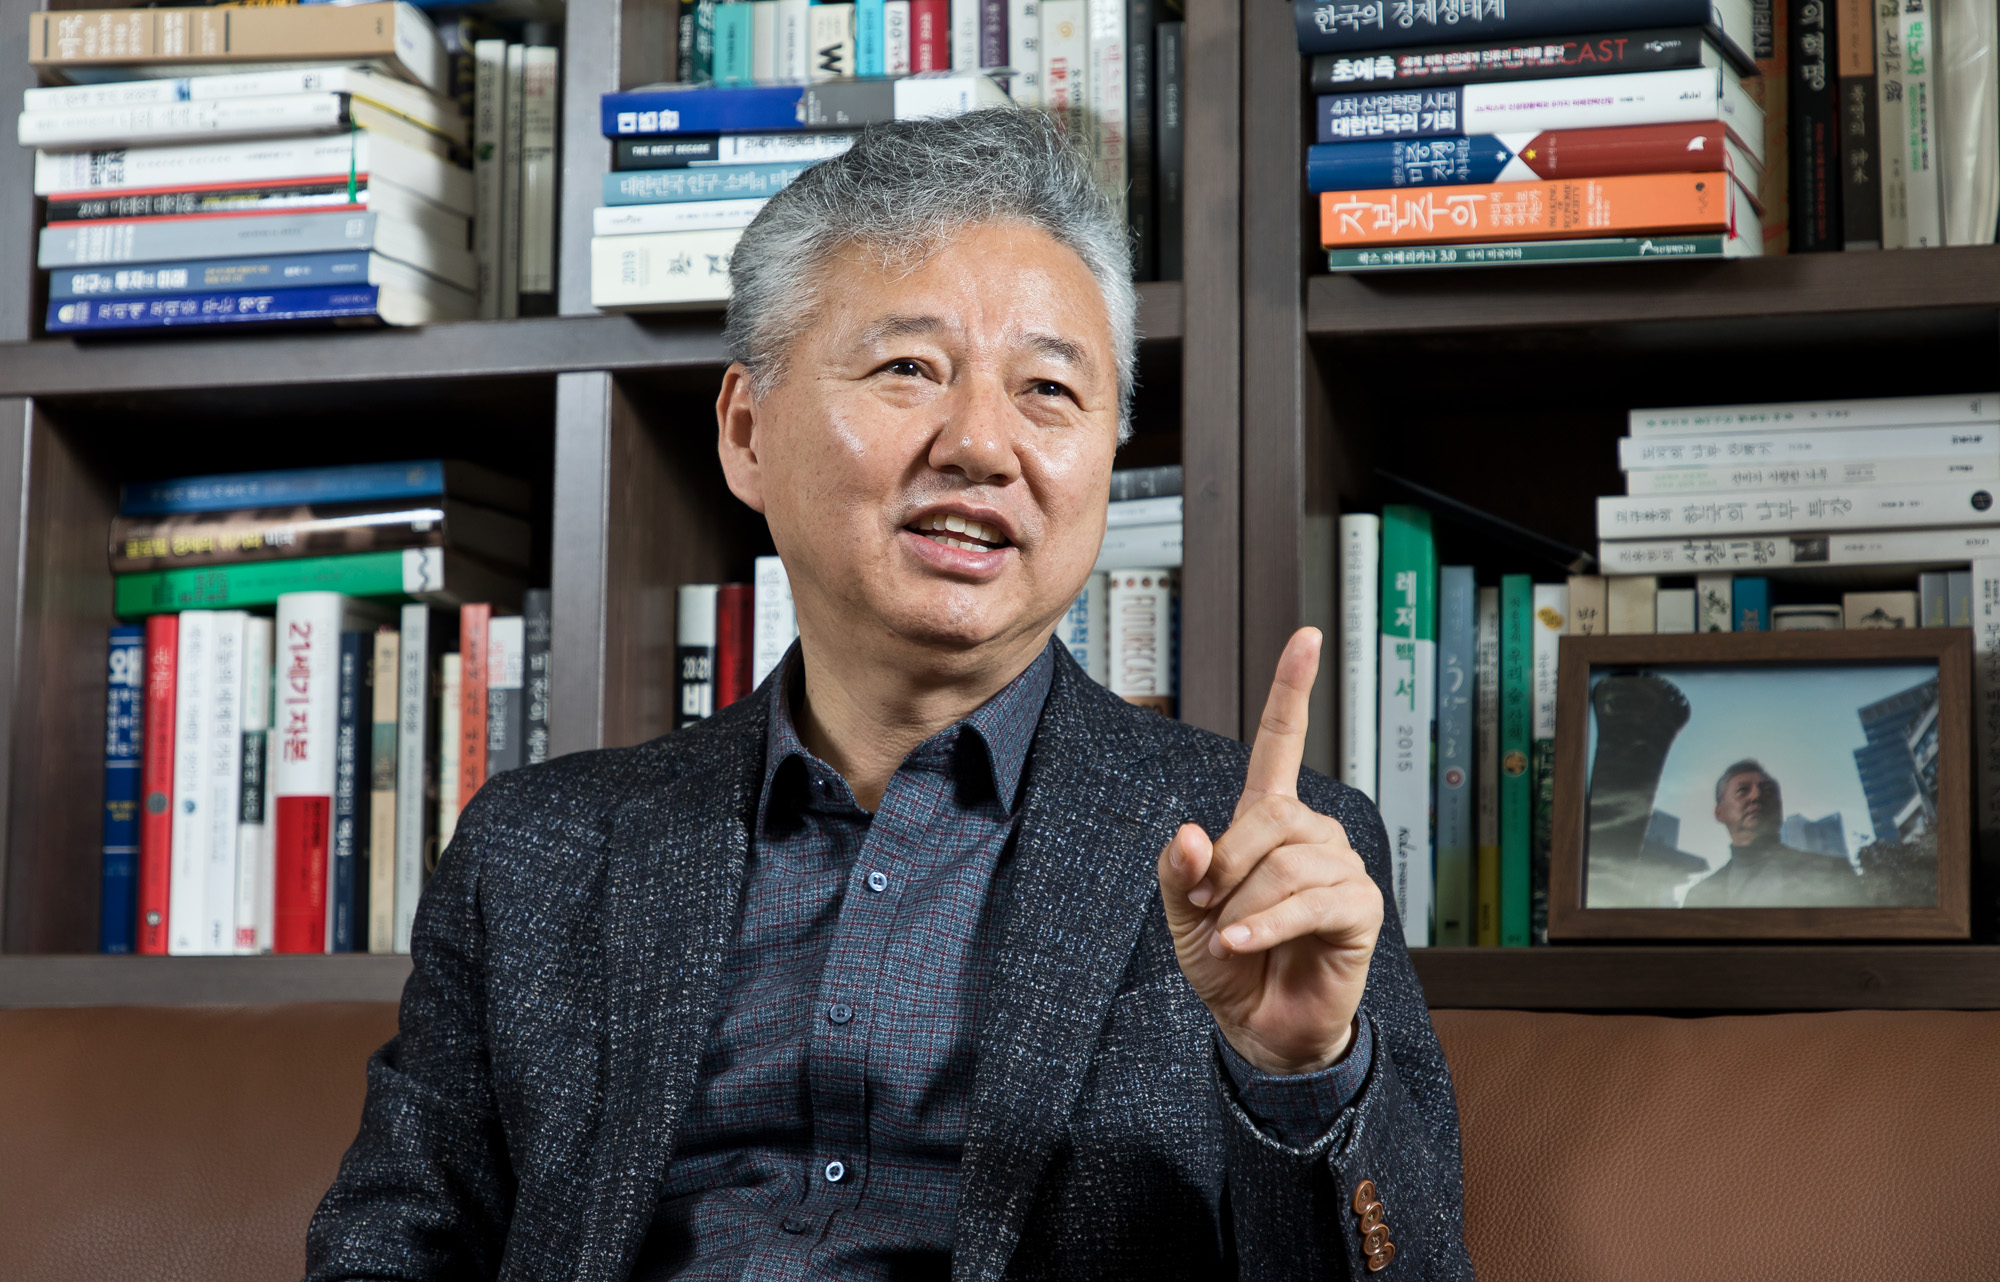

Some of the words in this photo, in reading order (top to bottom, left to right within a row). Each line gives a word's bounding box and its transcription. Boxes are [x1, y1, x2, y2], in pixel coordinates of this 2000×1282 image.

[1313, 1, 1383, 34] 한국의
[1392, 0, 1505, 29] 경제생태계
[1331, 56, 1396, 82] 초예측
[1482, 48, 1511, 63] 인류의
[1512, 46, 1542, 59] 미래를
[1907, 21, 1926, 75] 박노자
[1330, 97, 1357, 116] 4차
[1361, 93, 1422, 115] 산업혁명
[1424, 91, 1456, 110] 시대
[1331, 112, 1418, 137] 대한민국의
[1421, 110, 1456, 131] 기회
[1404, 141, 1430, 183] 미중
[1429, 141, 1455, 181] 전쟁
[1456, 137, 1471, 181] 시나리오
[621, 174, 684, 197] 대한민국
[1333, 192, 1486, 236] 자본주의
[1383, 250, 1437, 262] 아메리카나
[1439, 250, 1457, 262] 3.0
[1682, 501, 1747, 524] 한국의
[1757, 501, 1800, 521] 나무
[1808, 499, 1853, 520] 특강
[1122, 595, 1157, 695] FUTURECAST
[1395, 570, 1417, 712] 레저백서
[288, 621, 312, 714] 21세기
[284, 718, 308, 764] 자본
[1397, 725, 1414, 774] 2015
